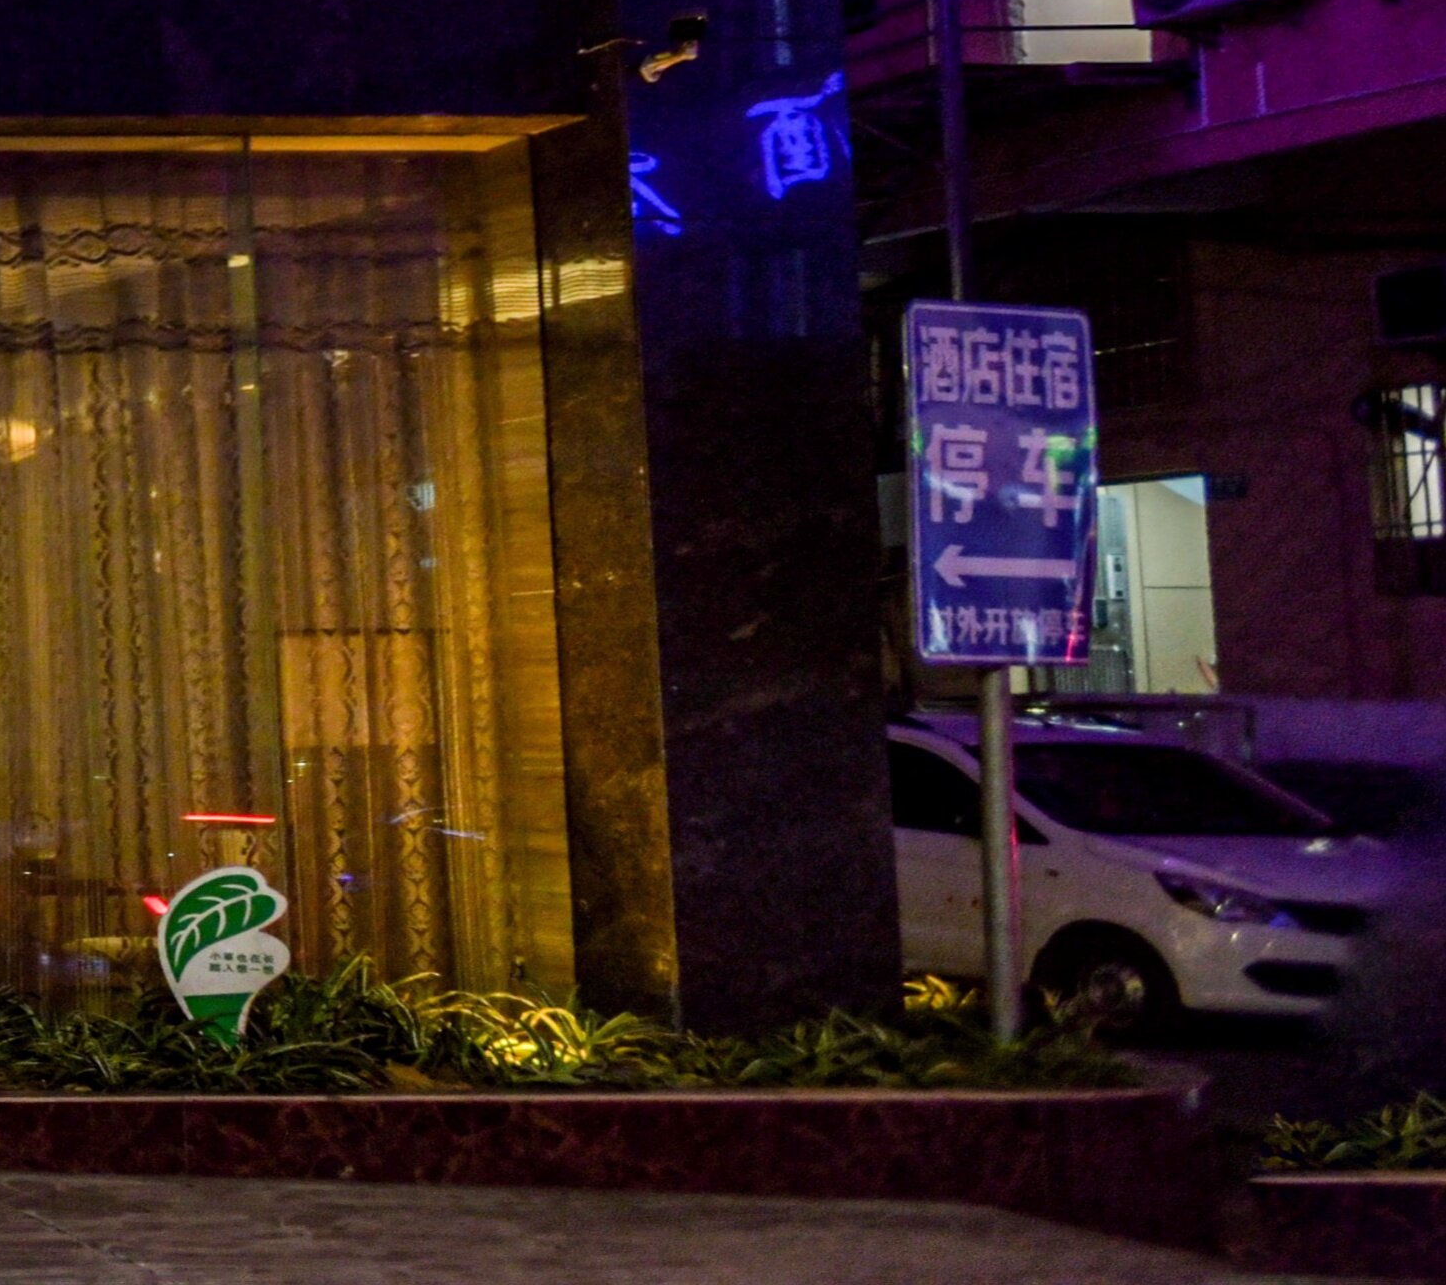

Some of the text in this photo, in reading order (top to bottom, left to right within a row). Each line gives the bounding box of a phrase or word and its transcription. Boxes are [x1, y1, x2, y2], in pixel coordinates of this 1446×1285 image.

[920, 325, 1079, 410] 酒店住宿
[925, 423, 1078, 528] 停车
